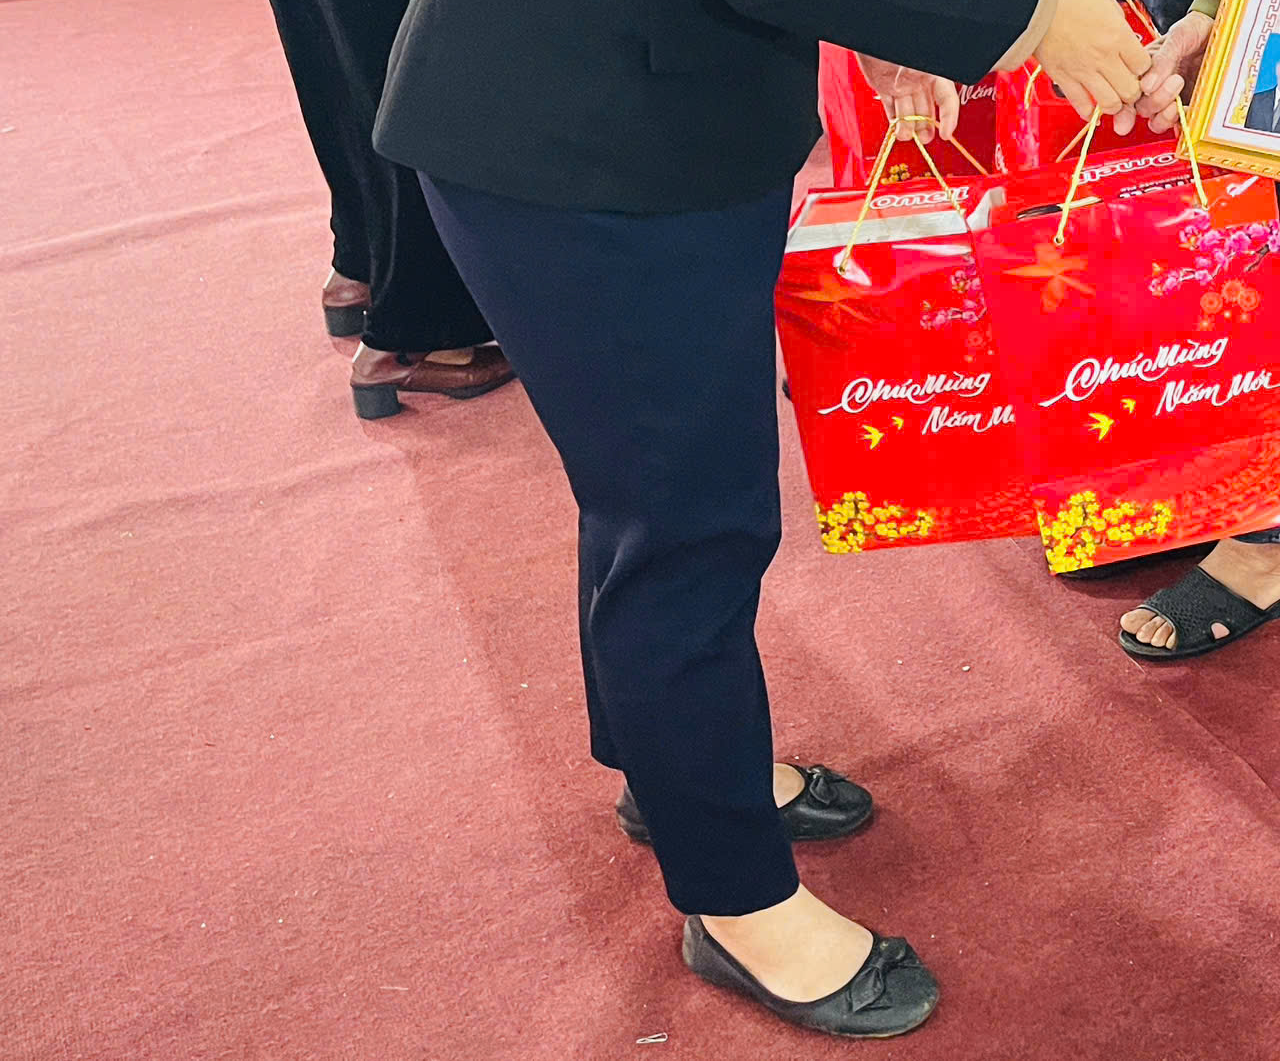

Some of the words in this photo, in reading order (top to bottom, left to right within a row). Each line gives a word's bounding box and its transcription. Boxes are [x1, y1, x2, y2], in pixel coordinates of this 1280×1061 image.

[817, 378, 935, 415] Chúc
[921, 371, 991, 398] Mừng
[1038, 352, 1168, 408] Chúc
[1154, 337, 1229, 368] Mừng
[1155, 379, 1229, 417] Năm
[922, 405, 988, 436] Năm
